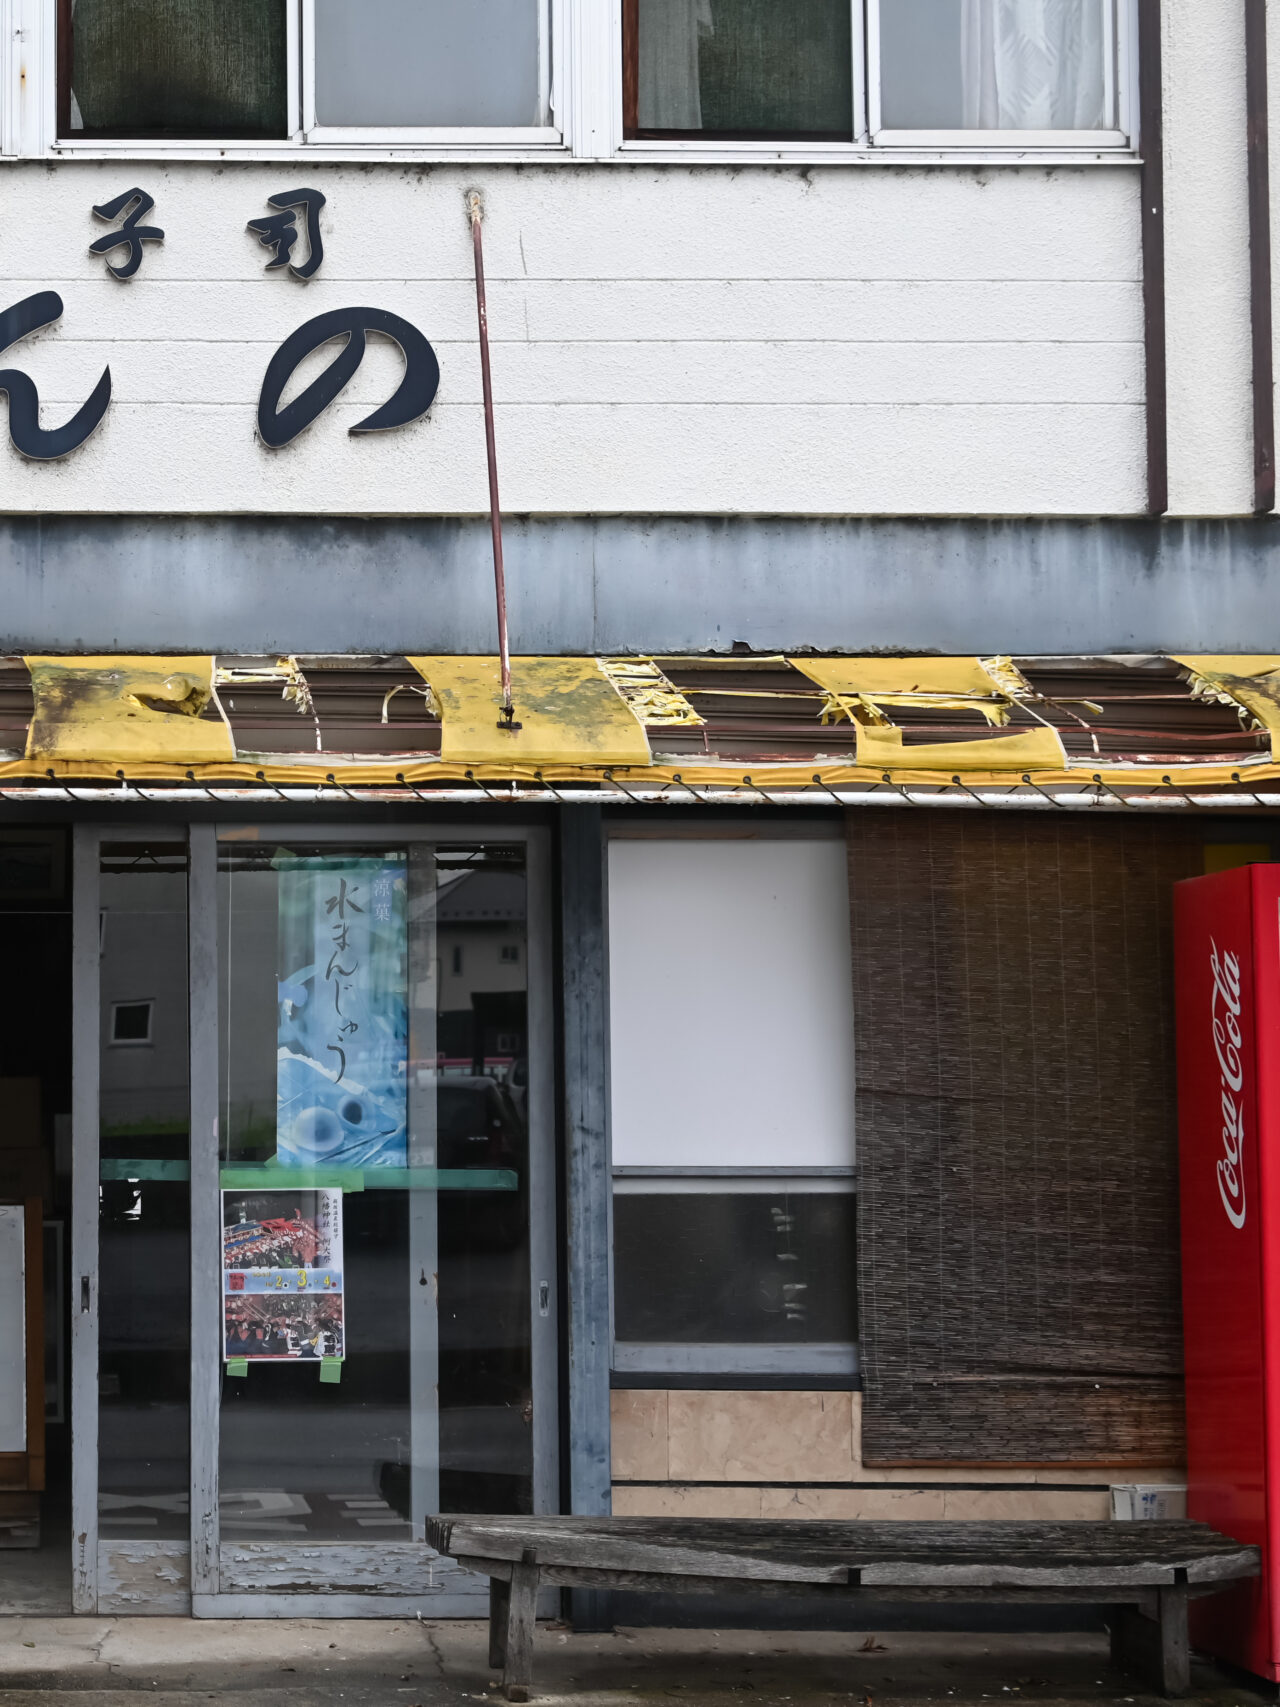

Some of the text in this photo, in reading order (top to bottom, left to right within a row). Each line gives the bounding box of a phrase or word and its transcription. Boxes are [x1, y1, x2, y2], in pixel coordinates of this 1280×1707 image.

[324, 877, 364, 1085] 水まんじゅう
[373, 878, 391, 922] 涼菓
[1209, 935, 1246, 1230] Coca-Cola
